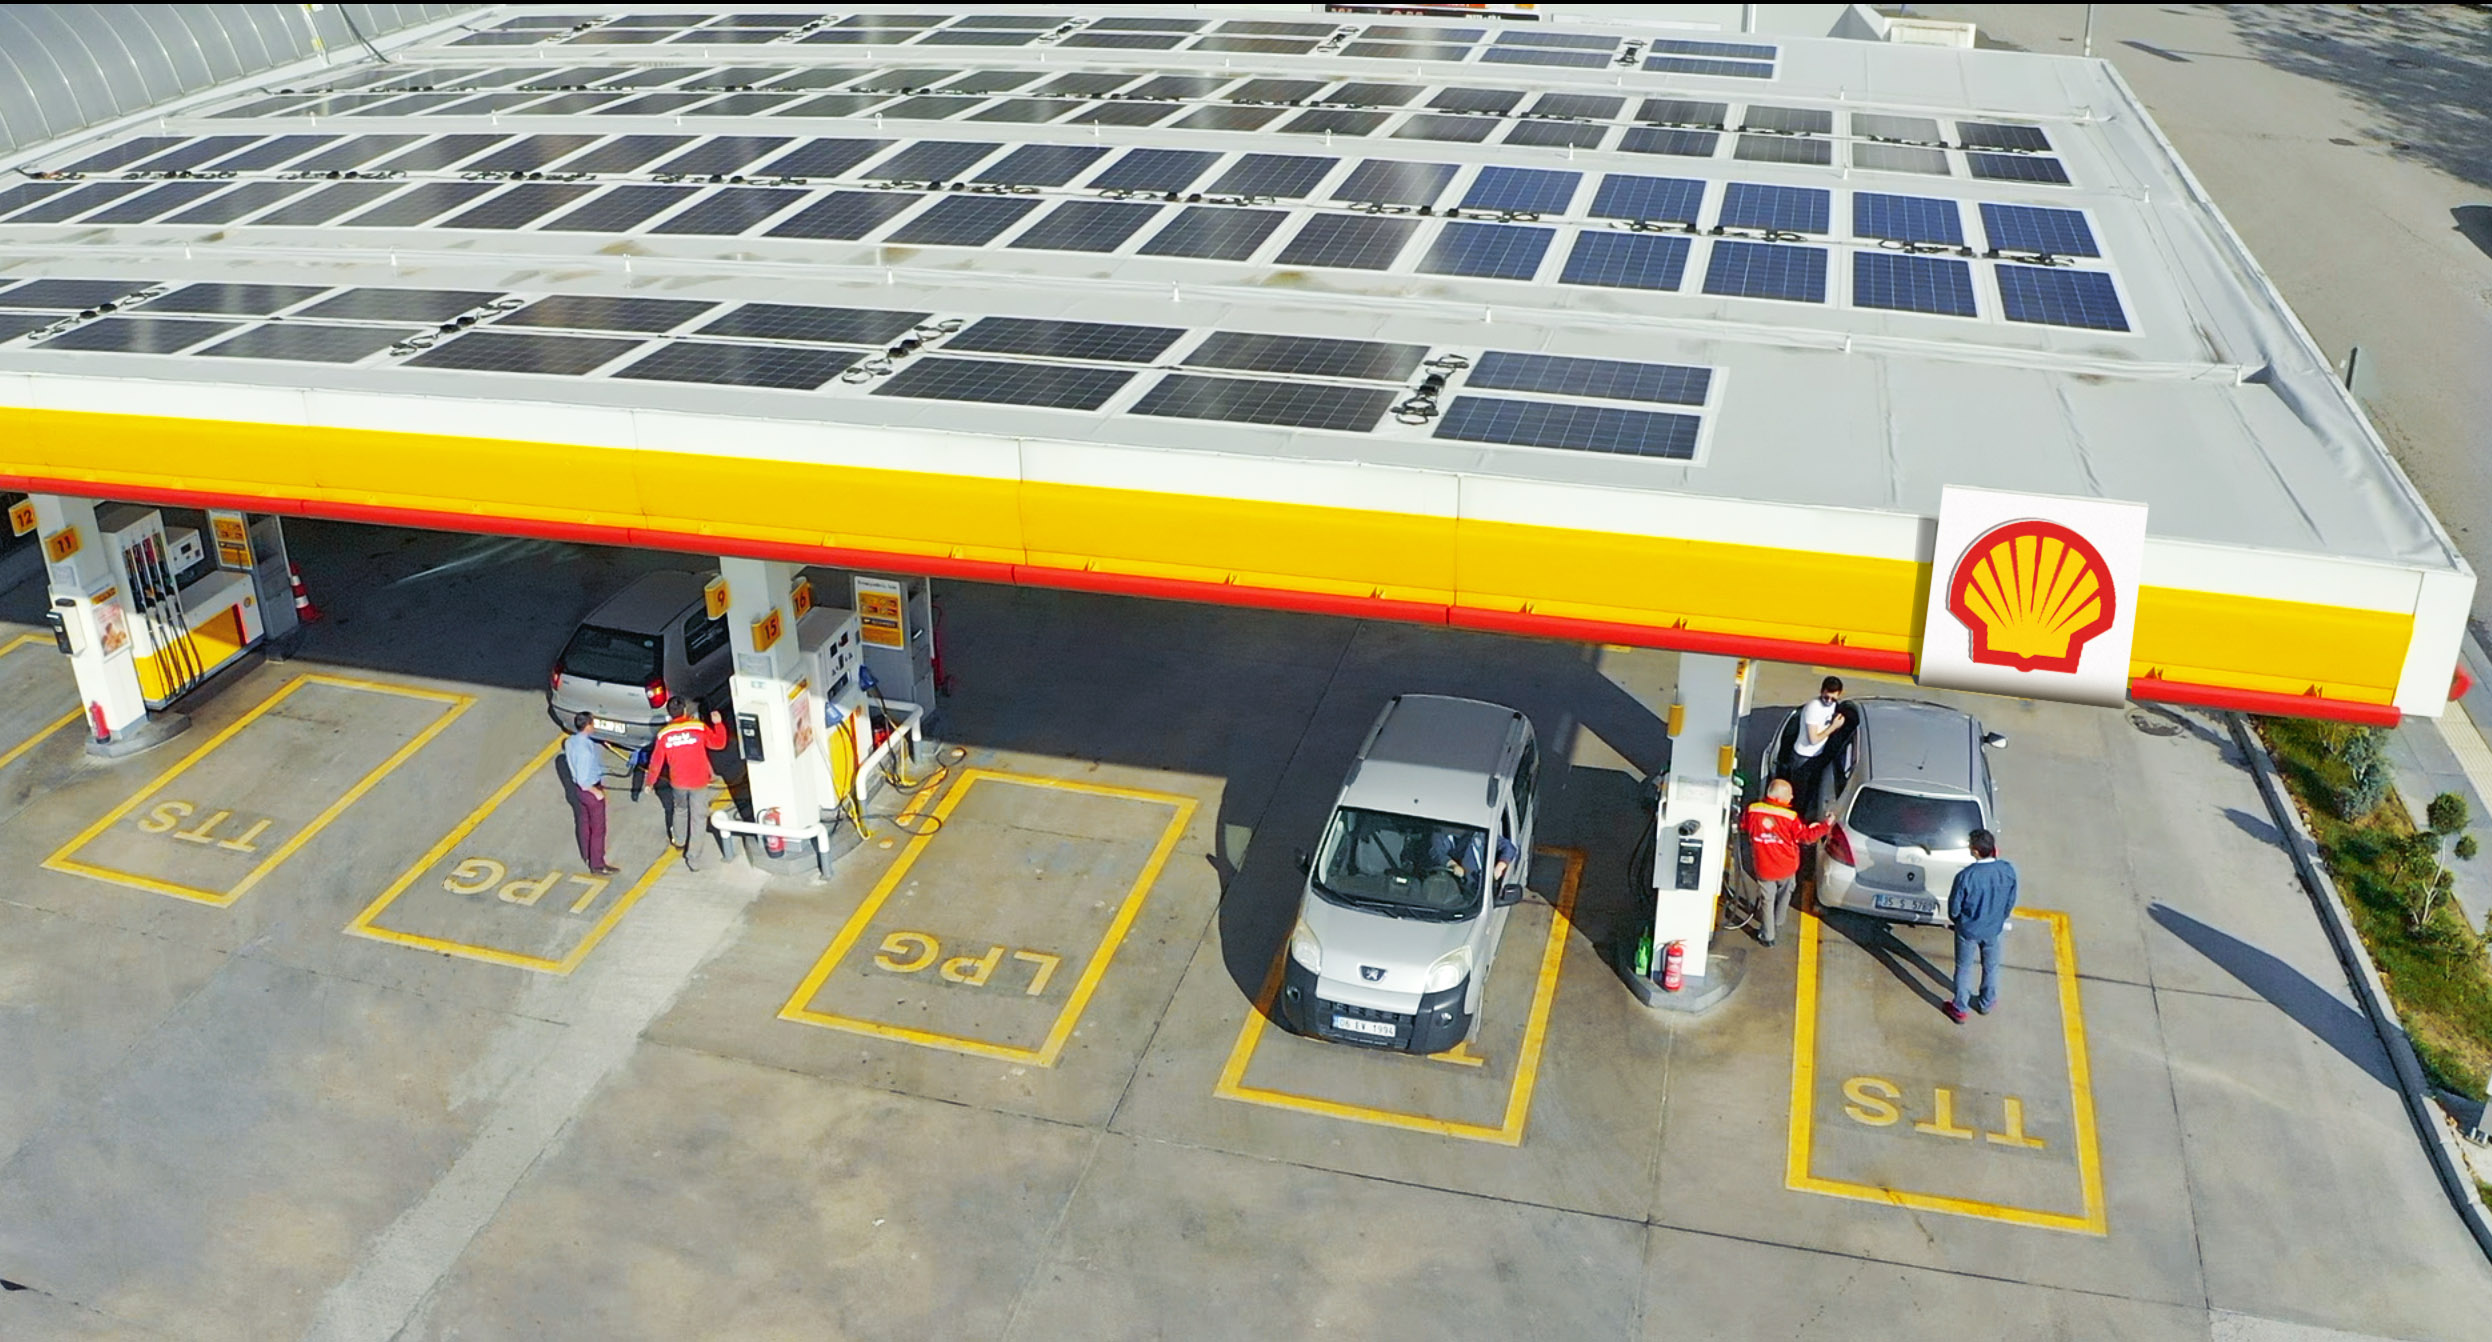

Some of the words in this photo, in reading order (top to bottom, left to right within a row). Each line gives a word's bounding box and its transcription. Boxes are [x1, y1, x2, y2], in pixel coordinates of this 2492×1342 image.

[17, 509, 34, 528] 12
[57, 535, 72, 553] 11
[717, 590, 726, 608] 9
[794, 592, 807, 613] 16
[764, 618, 777, 641] 15
[137, 801, 272, 853] TTS
[443, 857, 611, 914] LPG
[874, 931, 1061, 996] LPG
[1843, 1076, 2045, 1149] TTS
